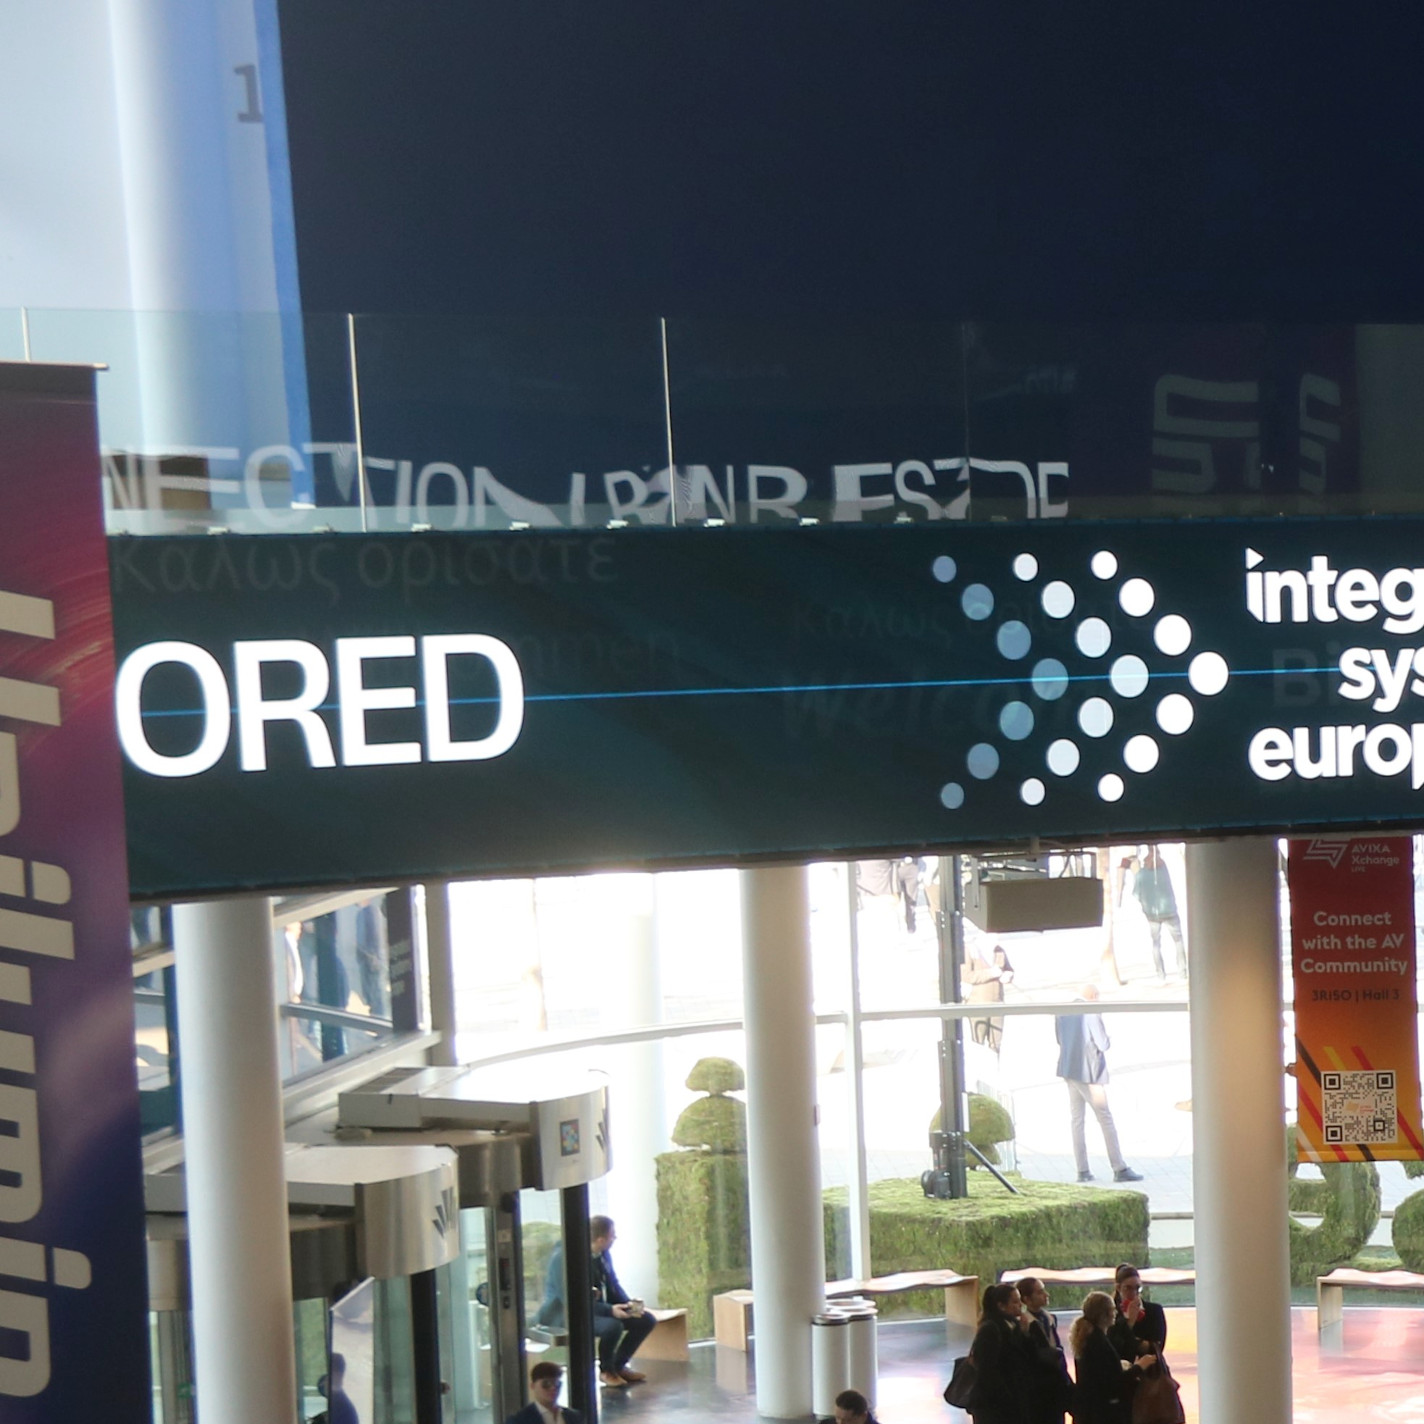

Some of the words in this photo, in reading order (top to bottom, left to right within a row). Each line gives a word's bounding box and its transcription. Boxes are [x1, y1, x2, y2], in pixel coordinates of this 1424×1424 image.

[115, 634, 524, 776] ORED
[1351, 843, 1391, 853] AVIXA
[1351, 855, 1400, 867] Xchange
[1313, 911, 1392, 926] Connect
[1302, 934, 1342, 950] with
[1346, 934, 1377, 949] the
[1381, 933, 1405, 949] AV
[1300, 956, 1409, 976] Community
[1362, 988, 1389, 1001] Hall
[1392, 988, 1400, 1001] 3
